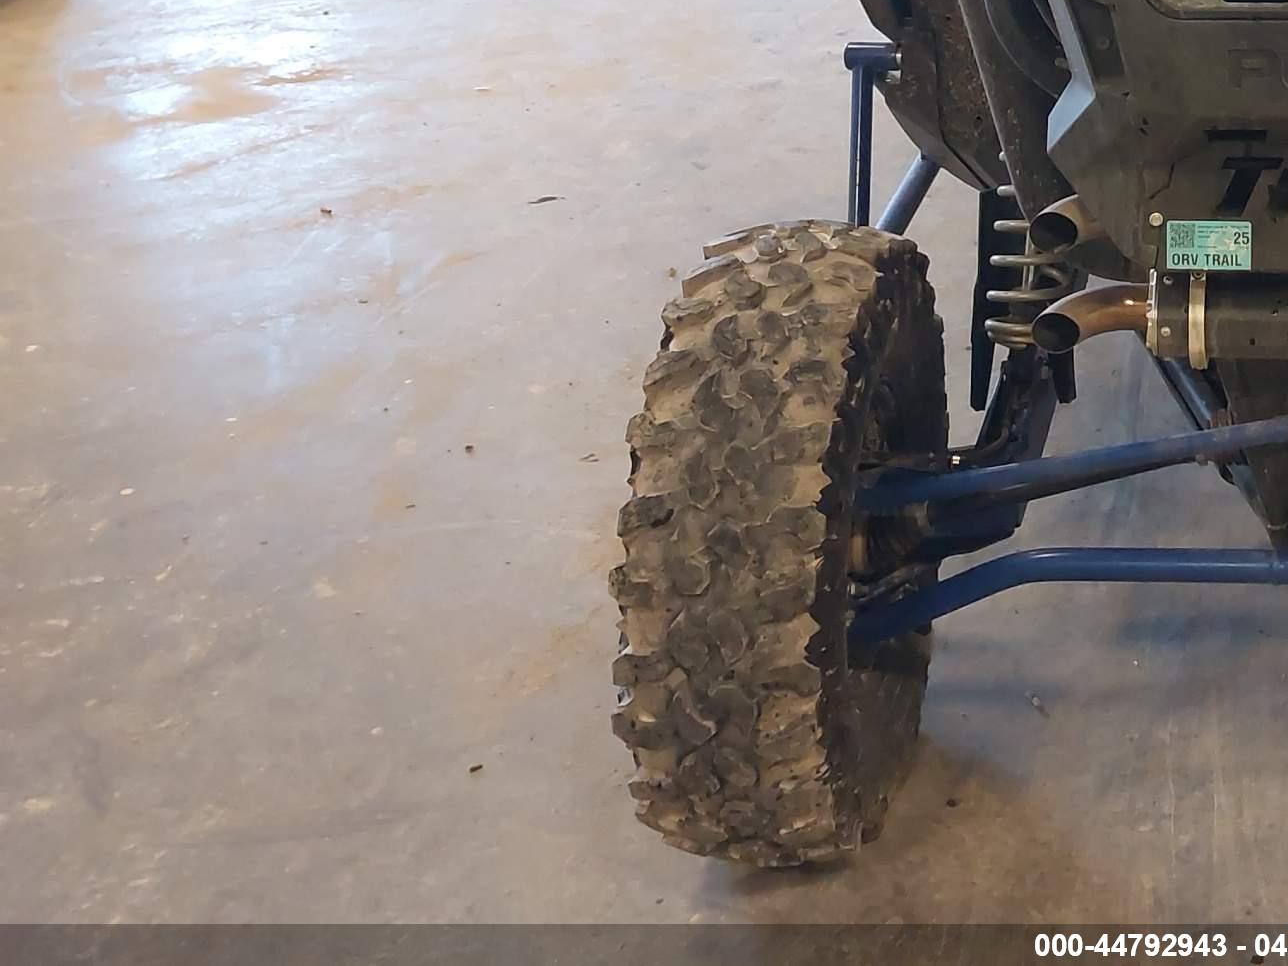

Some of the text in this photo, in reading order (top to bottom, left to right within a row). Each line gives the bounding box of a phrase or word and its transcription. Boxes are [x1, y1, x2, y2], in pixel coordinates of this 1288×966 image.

[1233, 231, 1250, 245] 25
[1172, 253, 1242, 267] ORV TRAIL
